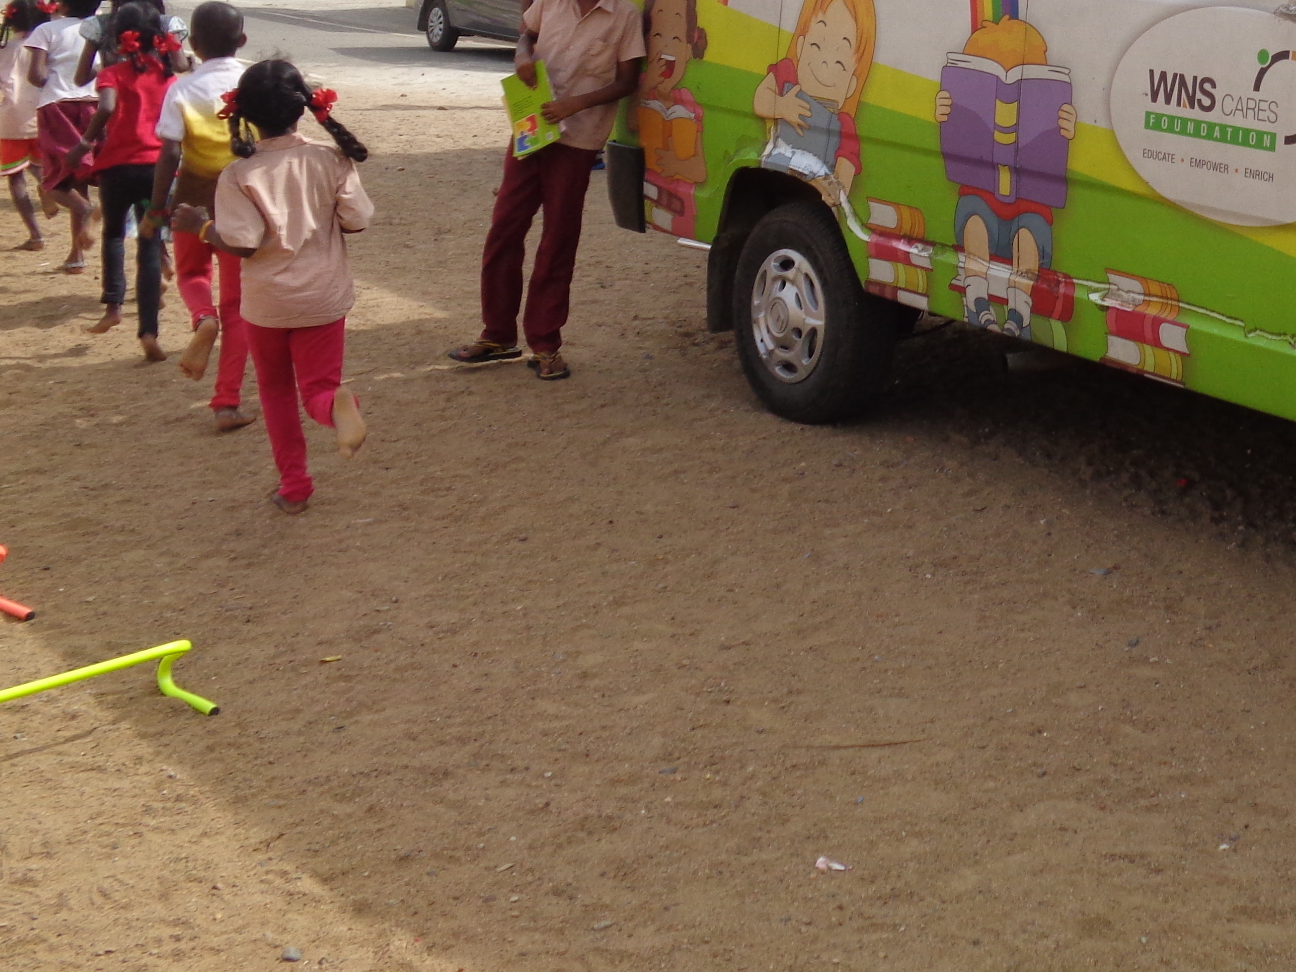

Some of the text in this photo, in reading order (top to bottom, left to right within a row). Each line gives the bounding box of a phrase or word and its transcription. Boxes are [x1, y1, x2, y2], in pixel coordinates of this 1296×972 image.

[1149, 68, 1279, 124] WNS CARES
[1148, 114, 1272, 148] FOUNDATION
[1142, 148, 1274, 183] EDUCATE EMPOWER ENRICH
